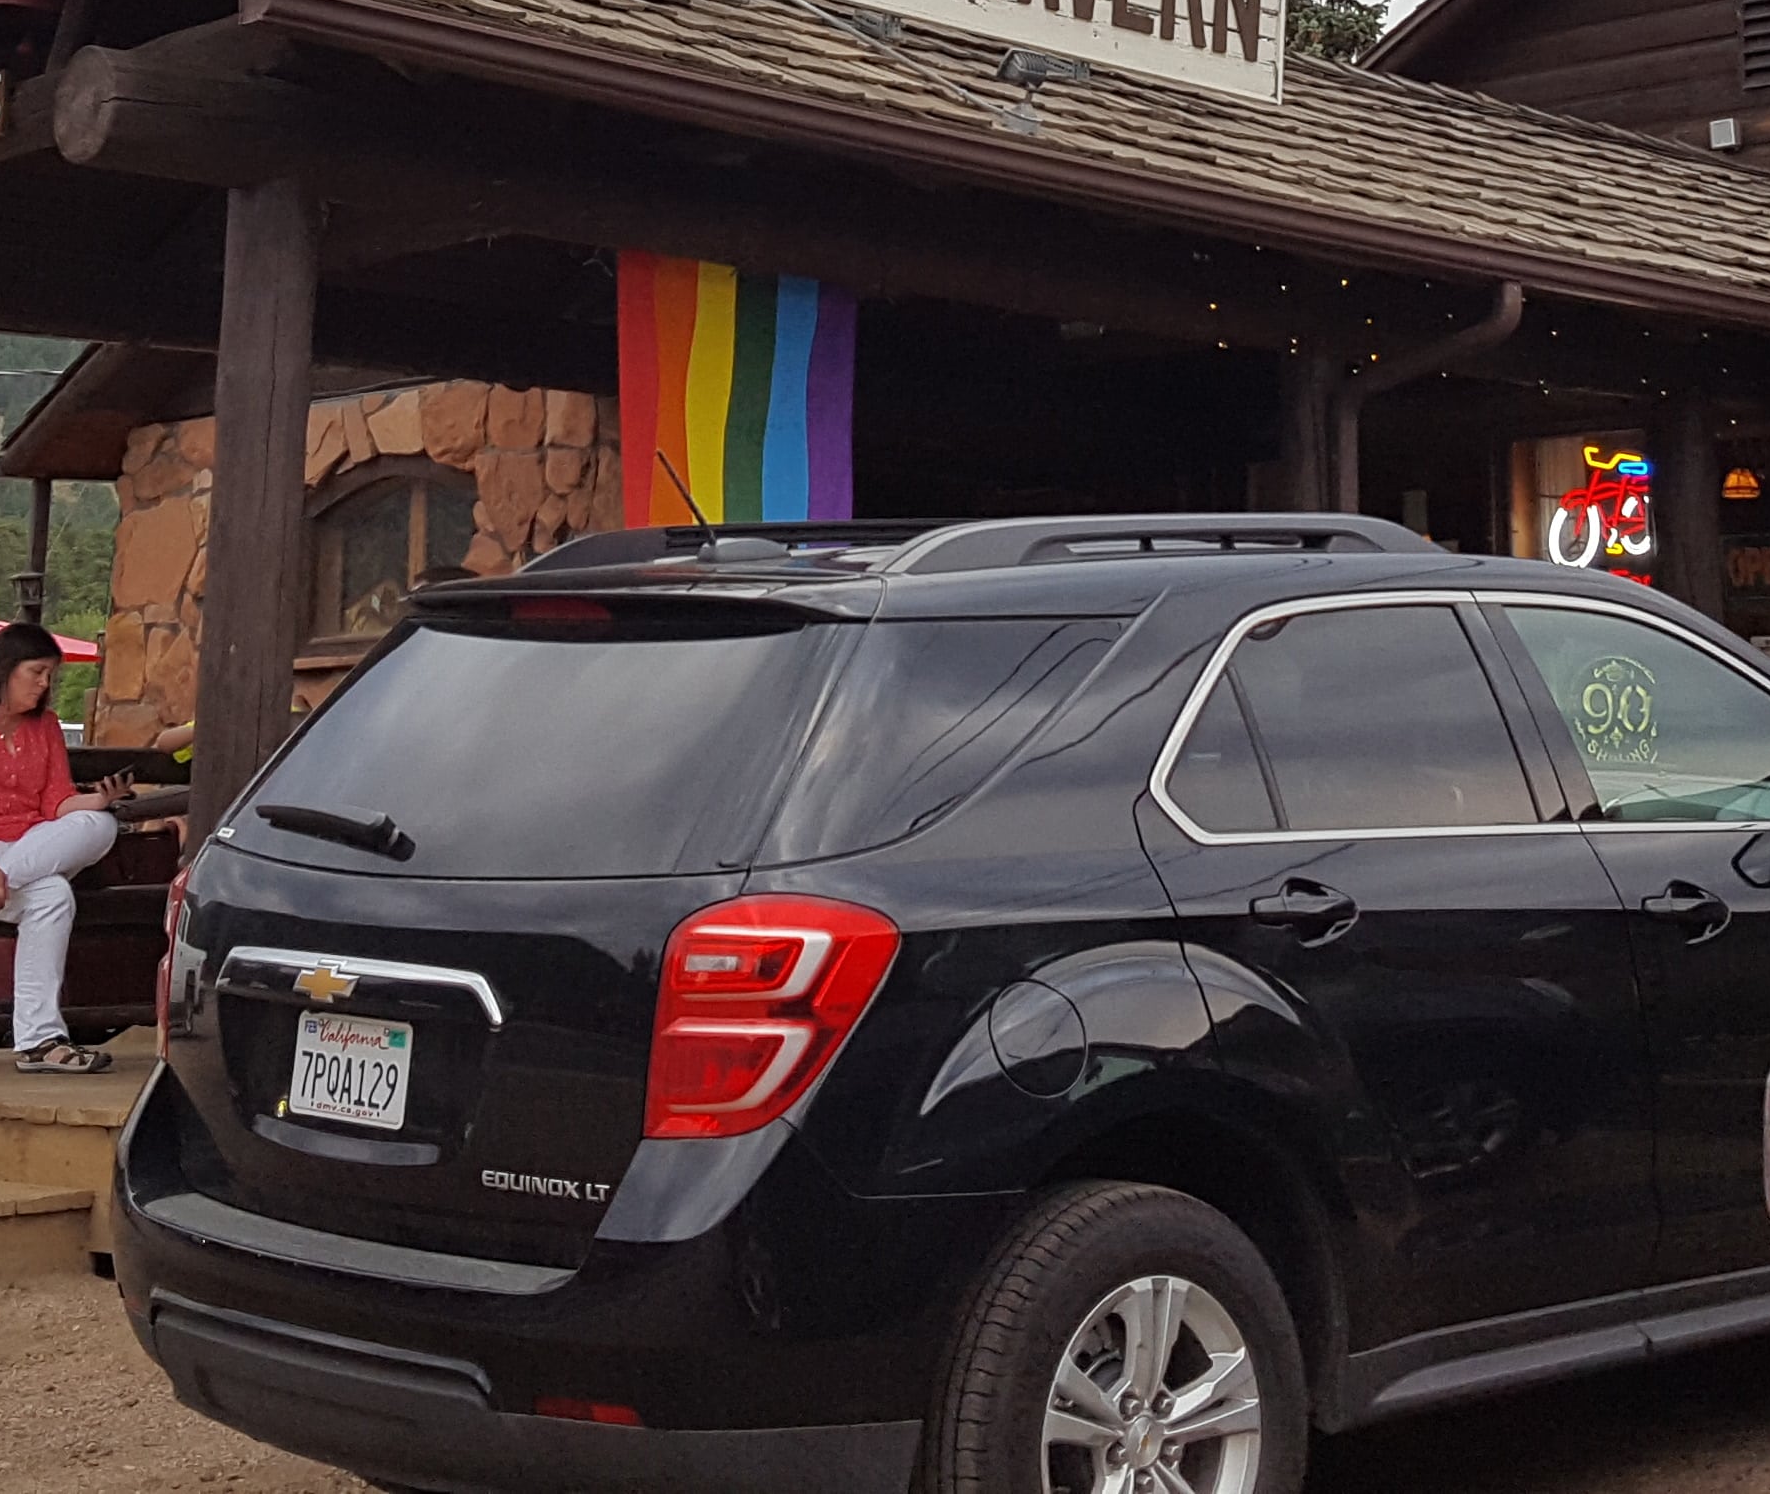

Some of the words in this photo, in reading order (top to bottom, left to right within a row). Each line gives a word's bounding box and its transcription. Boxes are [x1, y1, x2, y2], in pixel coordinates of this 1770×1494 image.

[1582, 682, 1653, 734] 90
[319, 1018, 390, 1052] California
[301, 1050, 399, 1111] 7PQA129
[481, 1169, 579, 1199] EQUINOX
[585, 1183, 610, 1202] LT
